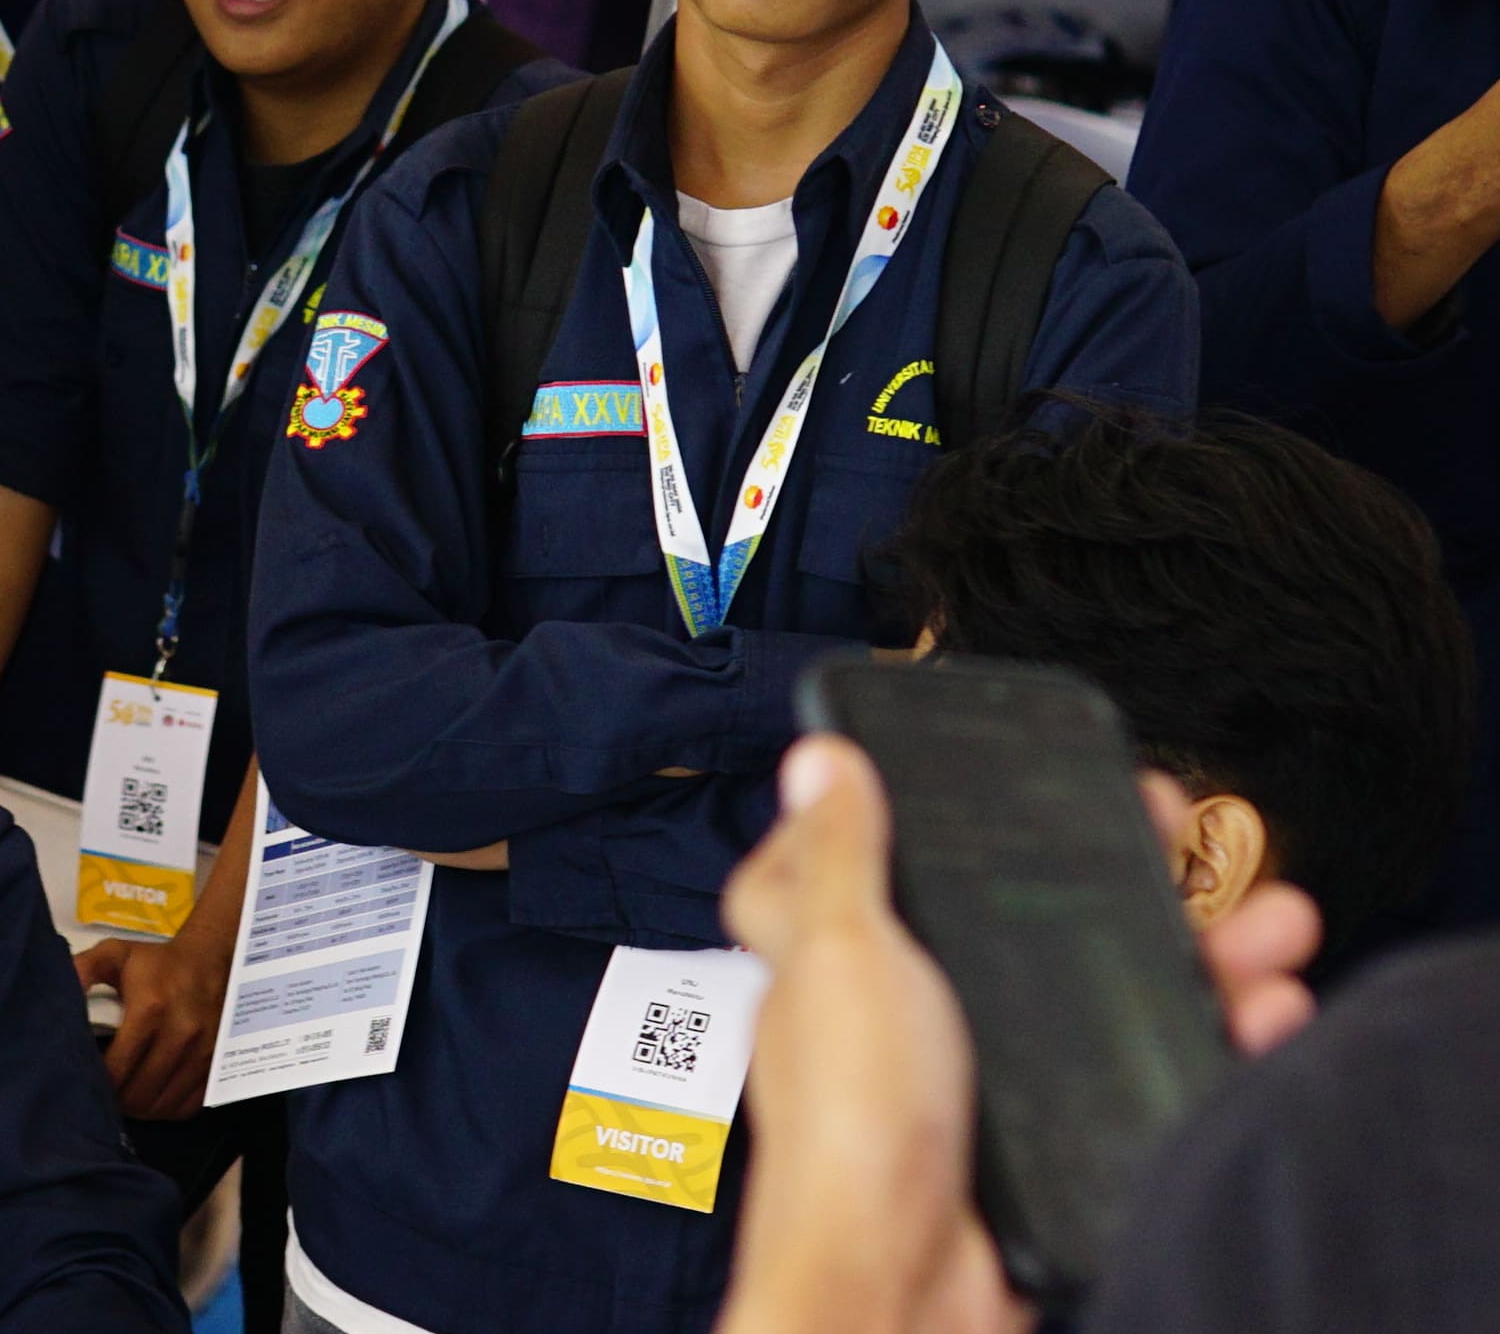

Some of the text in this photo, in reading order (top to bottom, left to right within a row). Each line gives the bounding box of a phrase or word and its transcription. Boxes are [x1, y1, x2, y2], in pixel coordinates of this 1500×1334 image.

[573, 391, 642, 426] XXVI
[866, 415, 924, 442] TEKNIK
[102, 879, 169, 909] VISITOR
[594, 1124, 687, 1165] VISITOR
